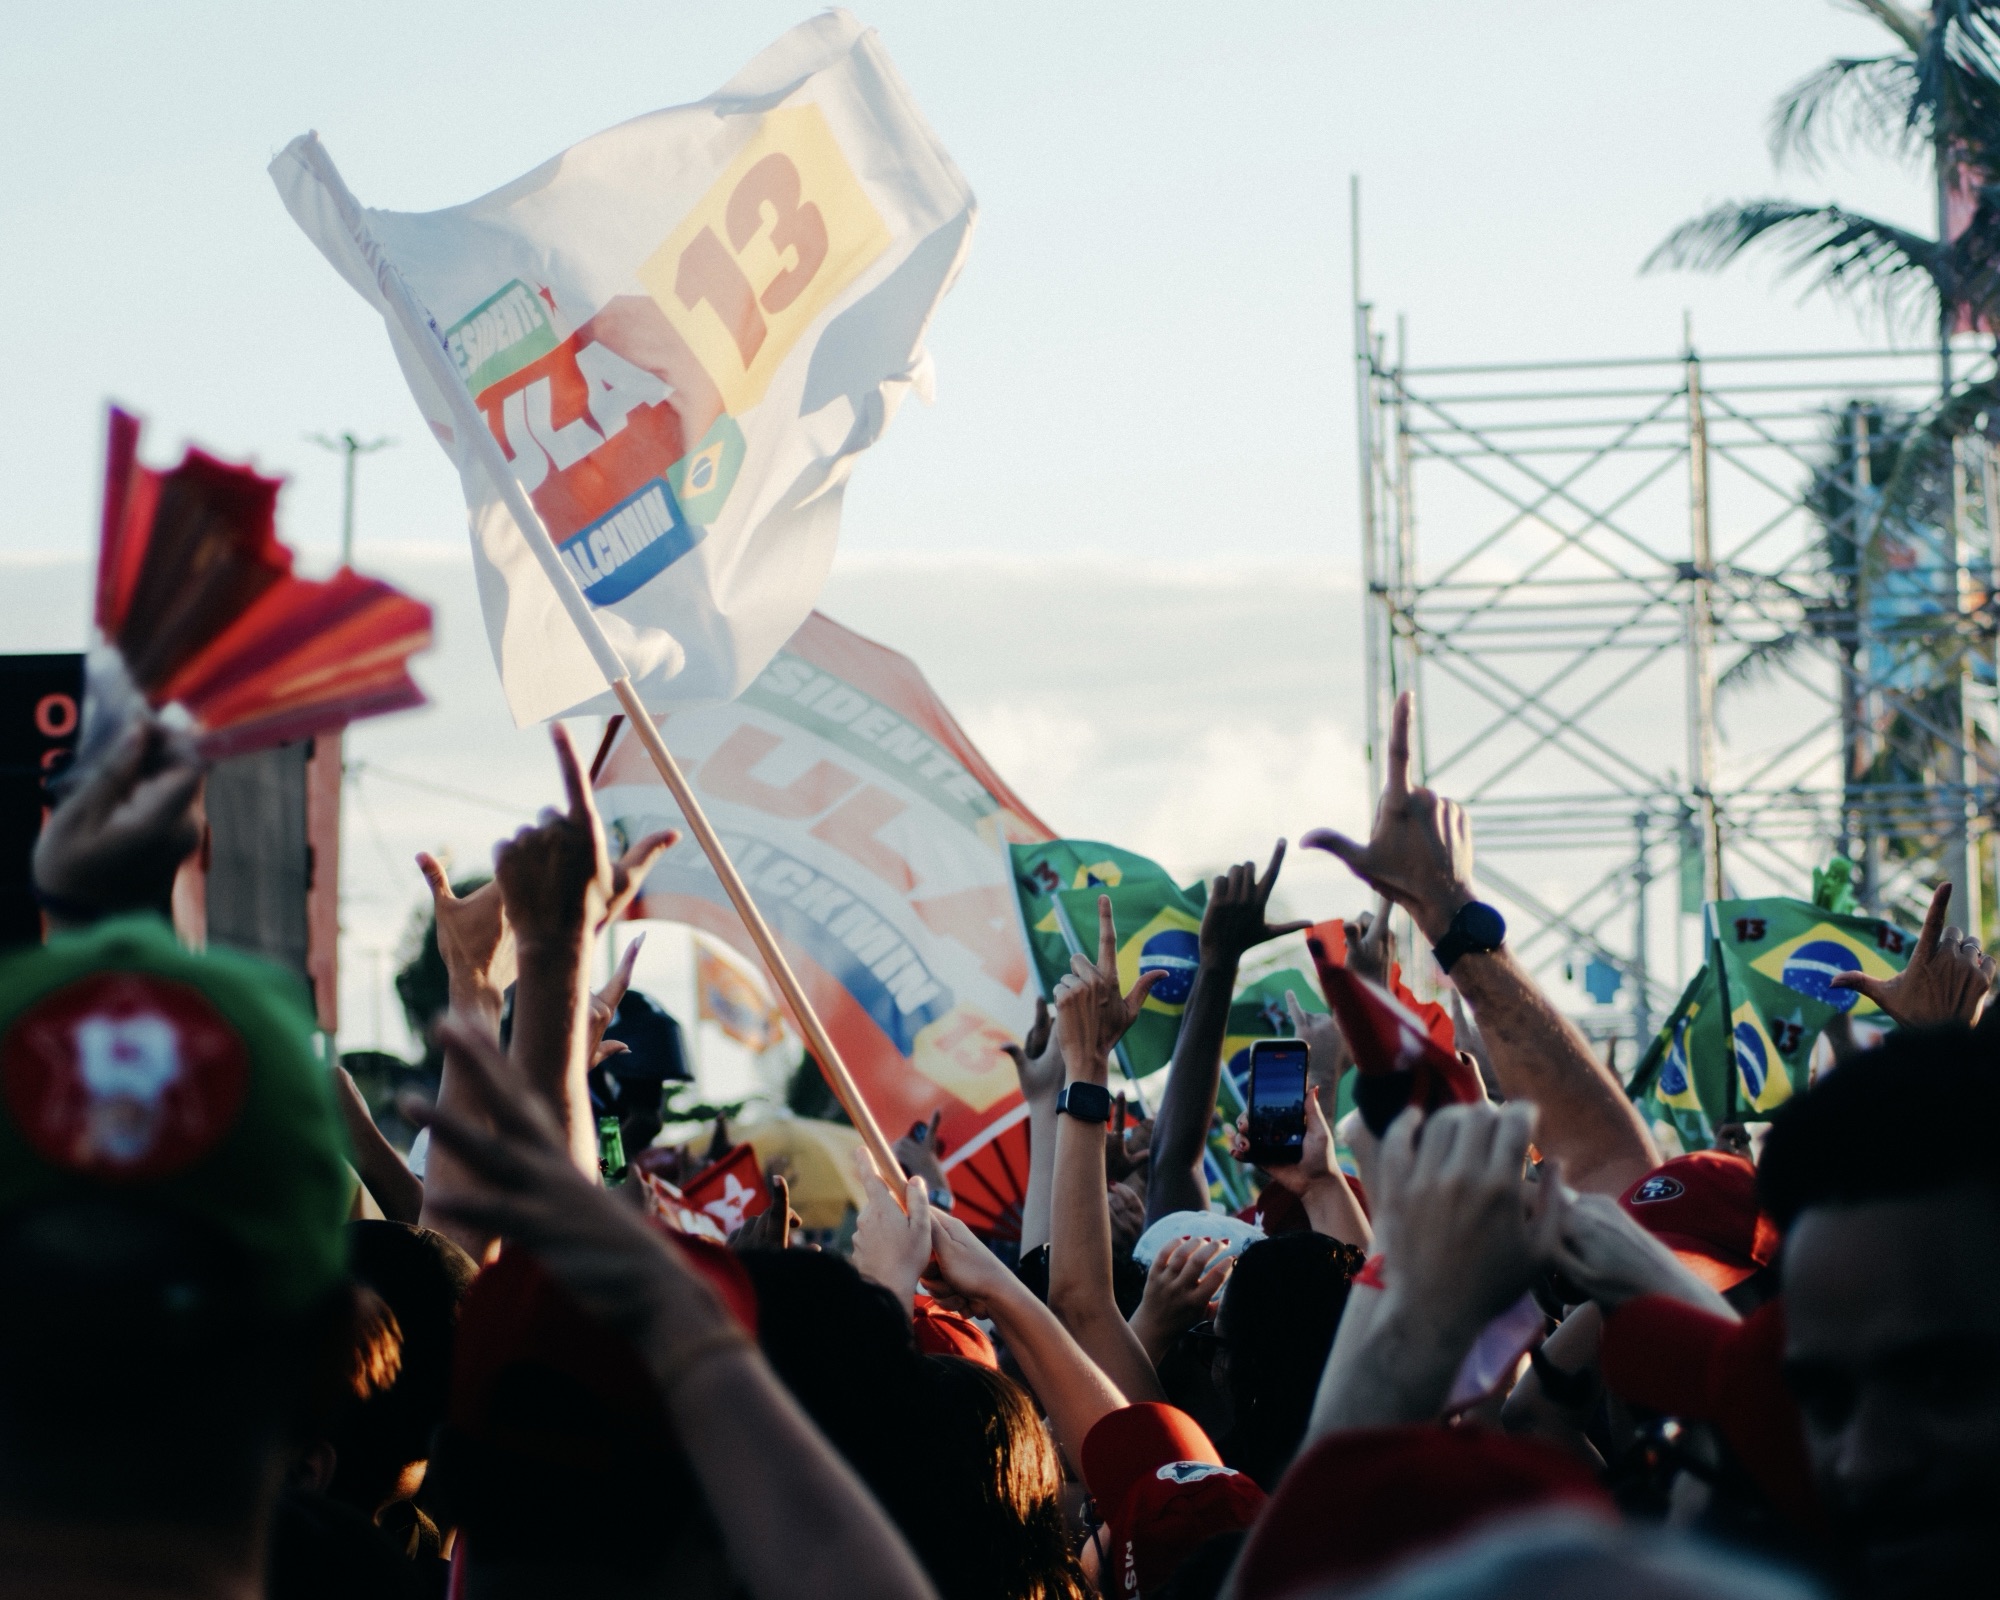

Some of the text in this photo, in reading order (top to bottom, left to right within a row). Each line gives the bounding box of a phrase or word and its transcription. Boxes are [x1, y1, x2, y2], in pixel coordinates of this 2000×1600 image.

[674, 152, 829, 371] 13
[448, 284, 545, 382] ESIDENTE
[483, 340, 676, 498] ULA
[559, 486, 675, 593] ALCKMIN
[760, 660, 998, 814] SIDENTE
[1735, 917, 1767, 942] 13
[1877, 926, 1904, 954] 13
[932, 1011, 1012, 1075] 13
